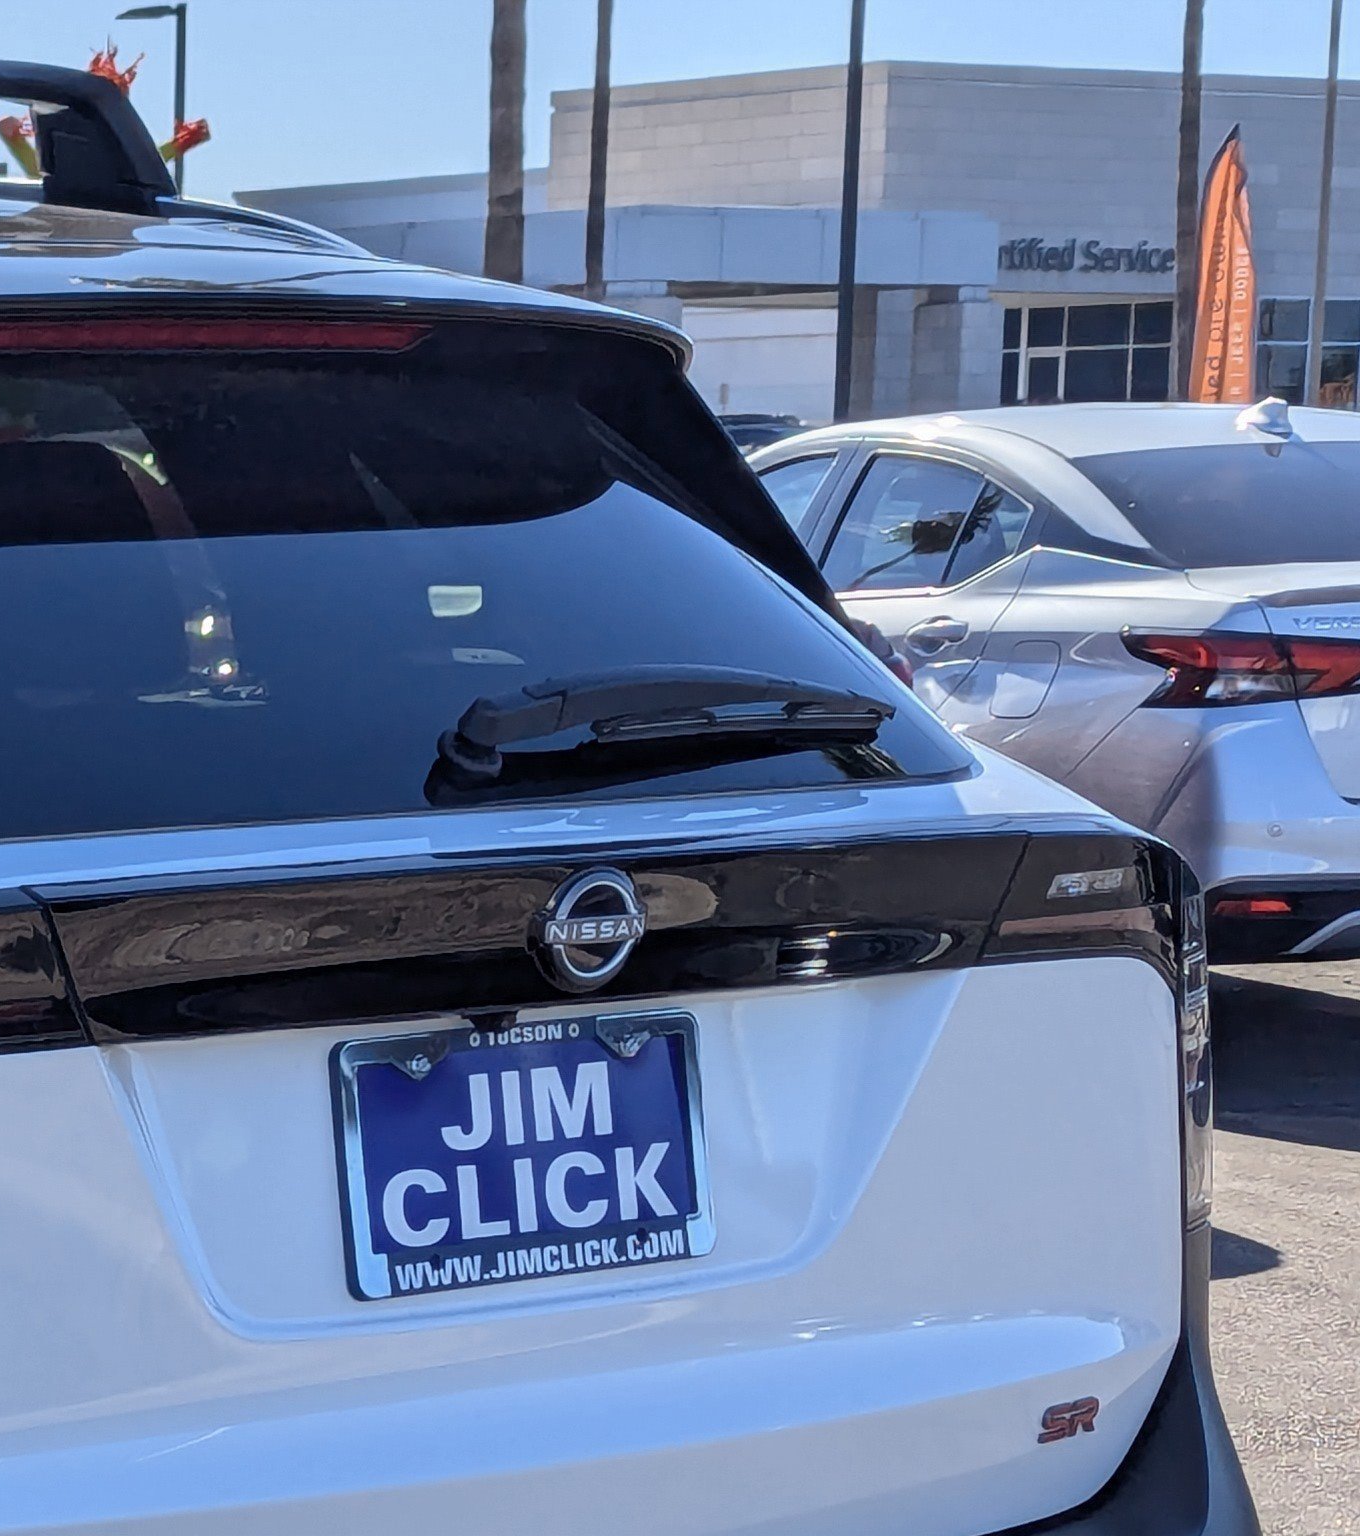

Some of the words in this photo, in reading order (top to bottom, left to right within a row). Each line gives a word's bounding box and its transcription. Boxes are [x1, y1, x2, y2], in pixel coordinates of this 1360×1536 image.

[1078, 239, 1176, 273] Service
[549, 917, 645, 941] NISSAN
[486, 1022, 563, 1046] TUCSON
[441, 1060, 613, 1151] JIM
[382, 1141, 679, 1247] CLICK
[394, 1229, 685, 1291] WWW.JIMCLICK.COM
[1037, 1395, 1100, 1444] SR
